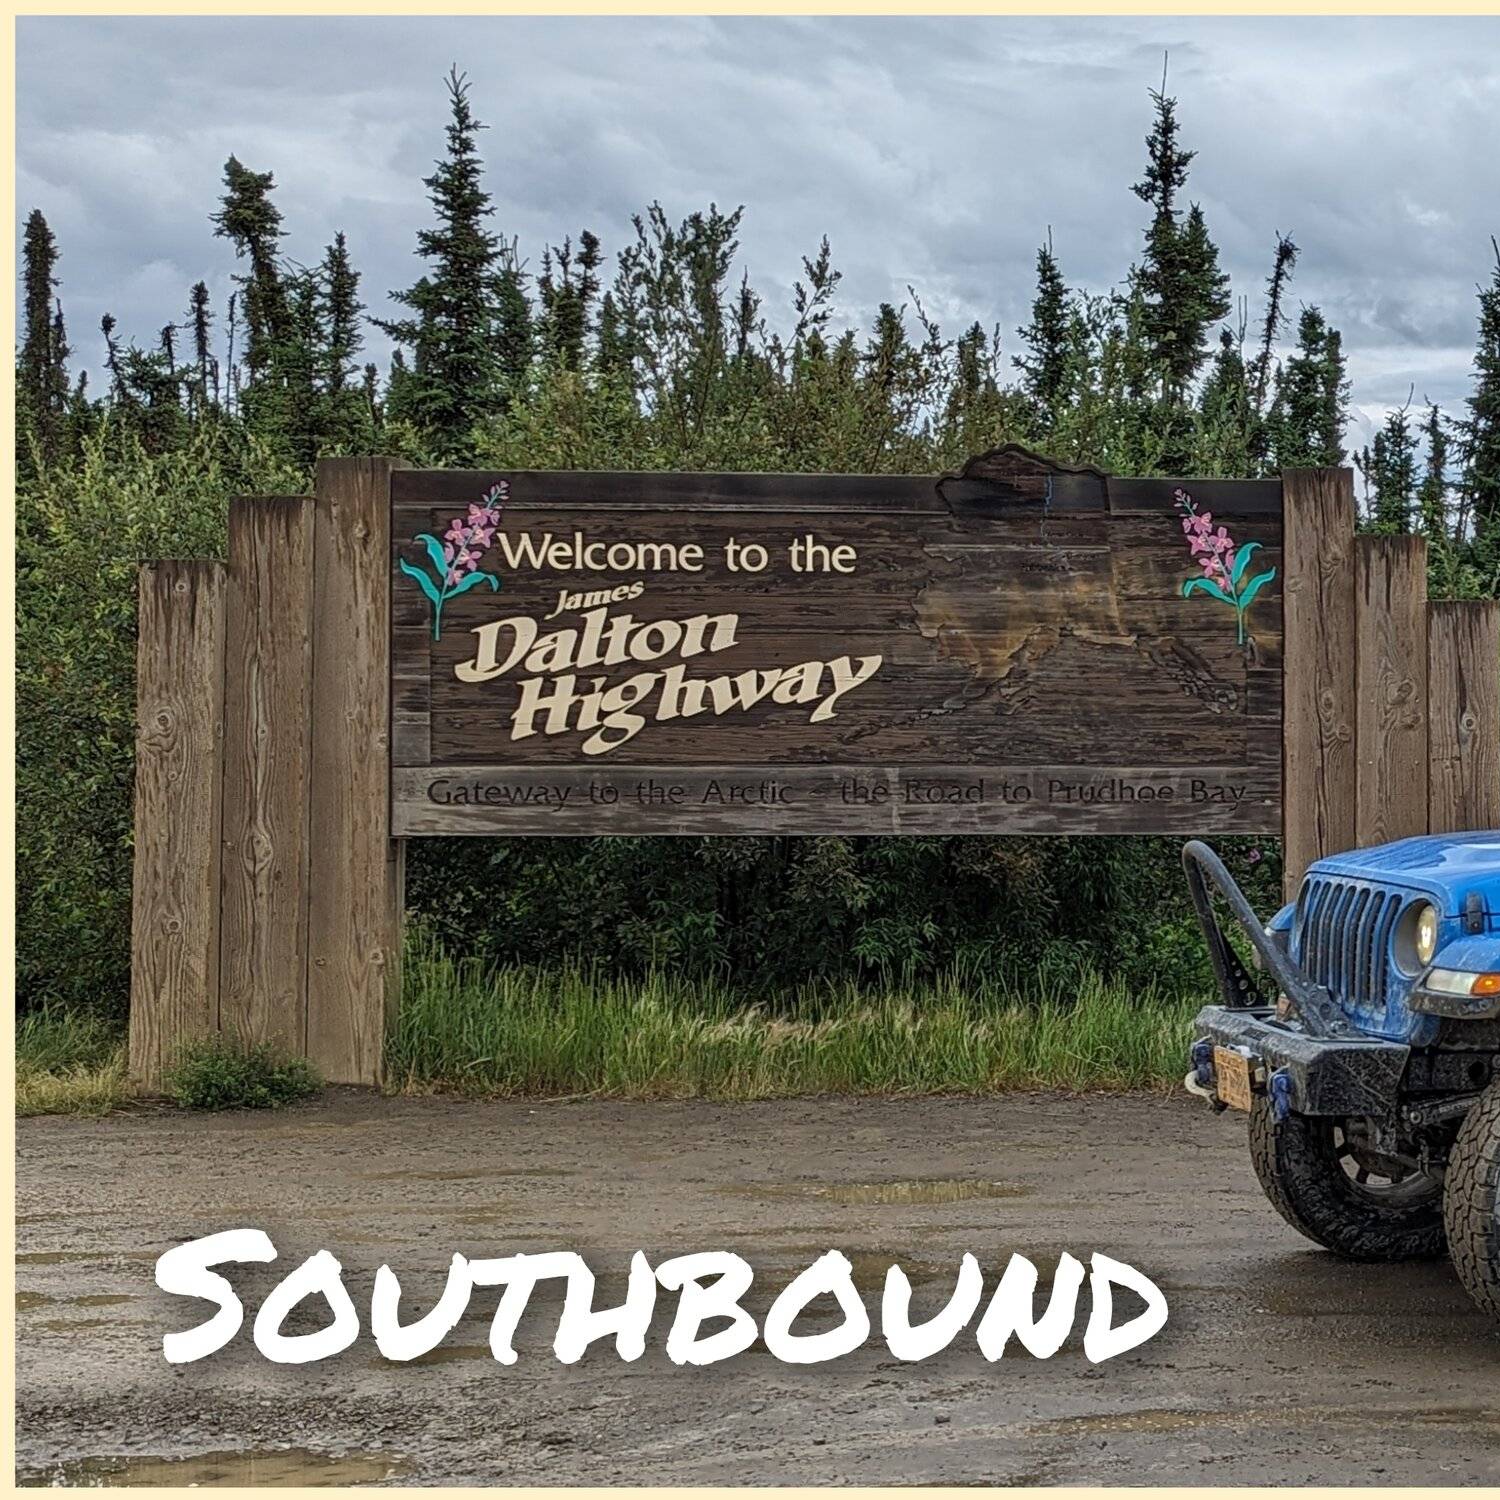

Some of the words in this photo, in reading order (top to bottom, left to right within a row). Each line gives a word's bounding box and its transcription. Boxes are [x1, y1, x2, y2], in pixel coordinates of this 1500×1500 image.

[498, 531, 704, 572] Welcome
[724, 537, 768, 572] to
[788, 534, 857, 573] the
[545, 579, 645, 620] James
[454, 607, 739, 683] Dalton
[511, 654, 883, 755] Highway
[427, 779, 572, 812] Gateway
[589, 781, 619, 806] to
[637, 778, 685, 806] the
[702, 779, 794, 806] Arctic
[842, 778, 889, 805] the
[905, 779, 984, 805] Road
[1002, 782, 1032, 805] to
[1048, 778, 1175, 805] Prudhoe
[1190, 779, 1247, 811] Bay
